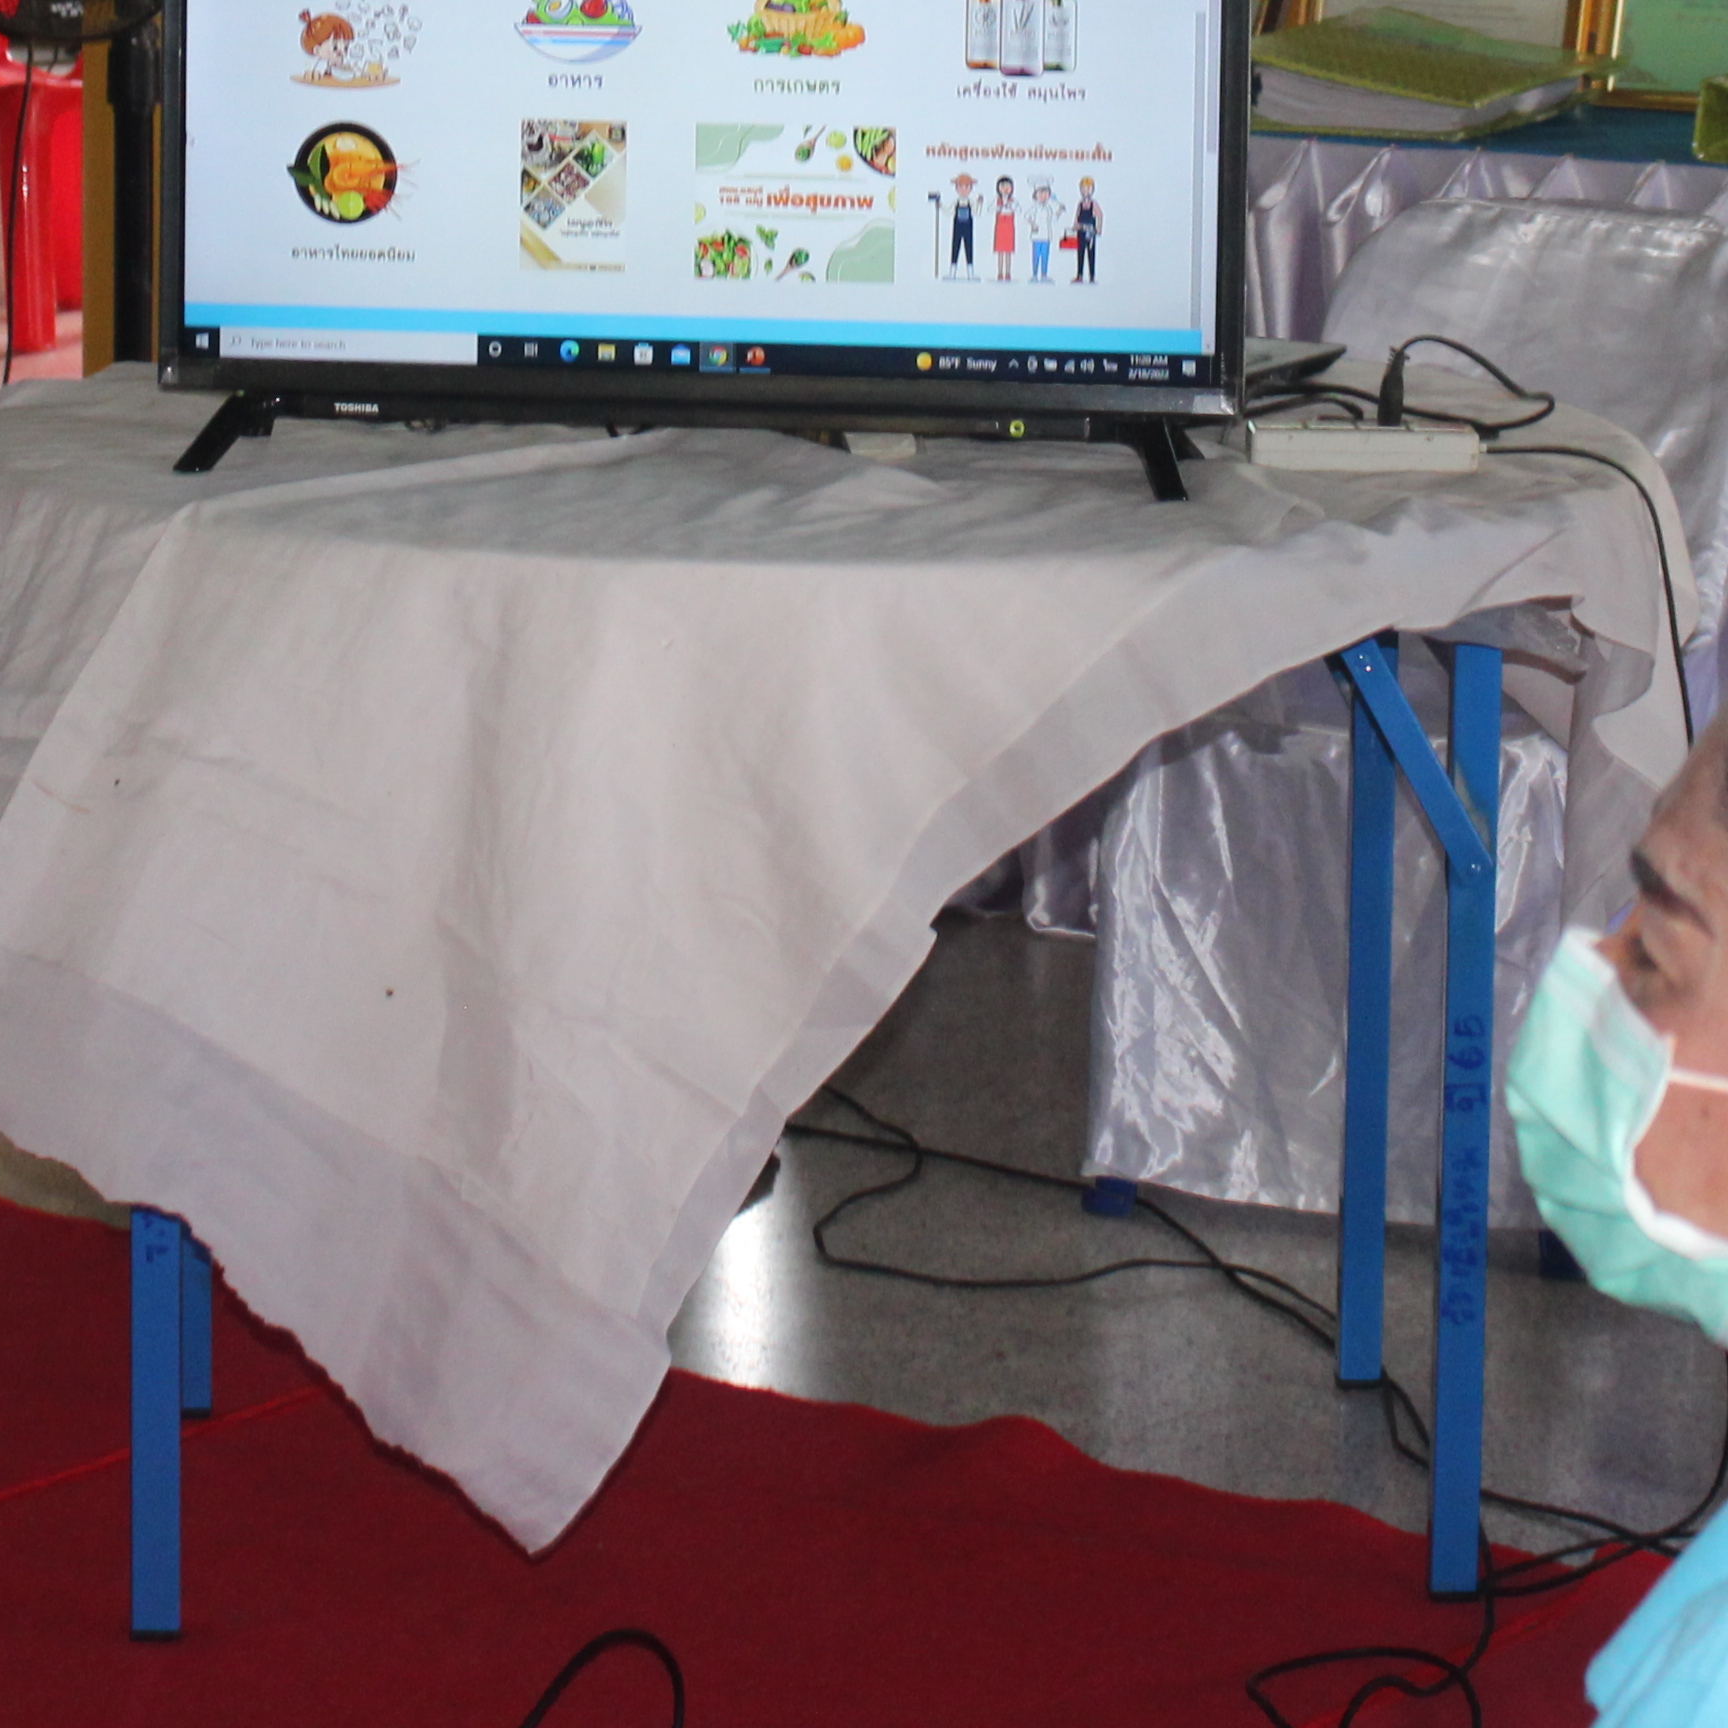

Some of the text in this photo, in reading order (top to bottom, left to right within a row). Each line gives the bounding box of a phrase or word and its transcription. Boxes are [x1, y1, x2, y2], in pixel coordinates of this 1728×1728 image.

[548, 73, 604, 90] อาหาร
[753, 79, 842, 95] การเกษตร
[766, 184, 874, 215] เพื่อสุขภาพ
[291, 243, 416, 263] อาหารไทยยอดนิยม
[275, 339, 299, 350] here
[314, 339, 346, 351] search
[334, 402, 380, 414] TOSHIBA
